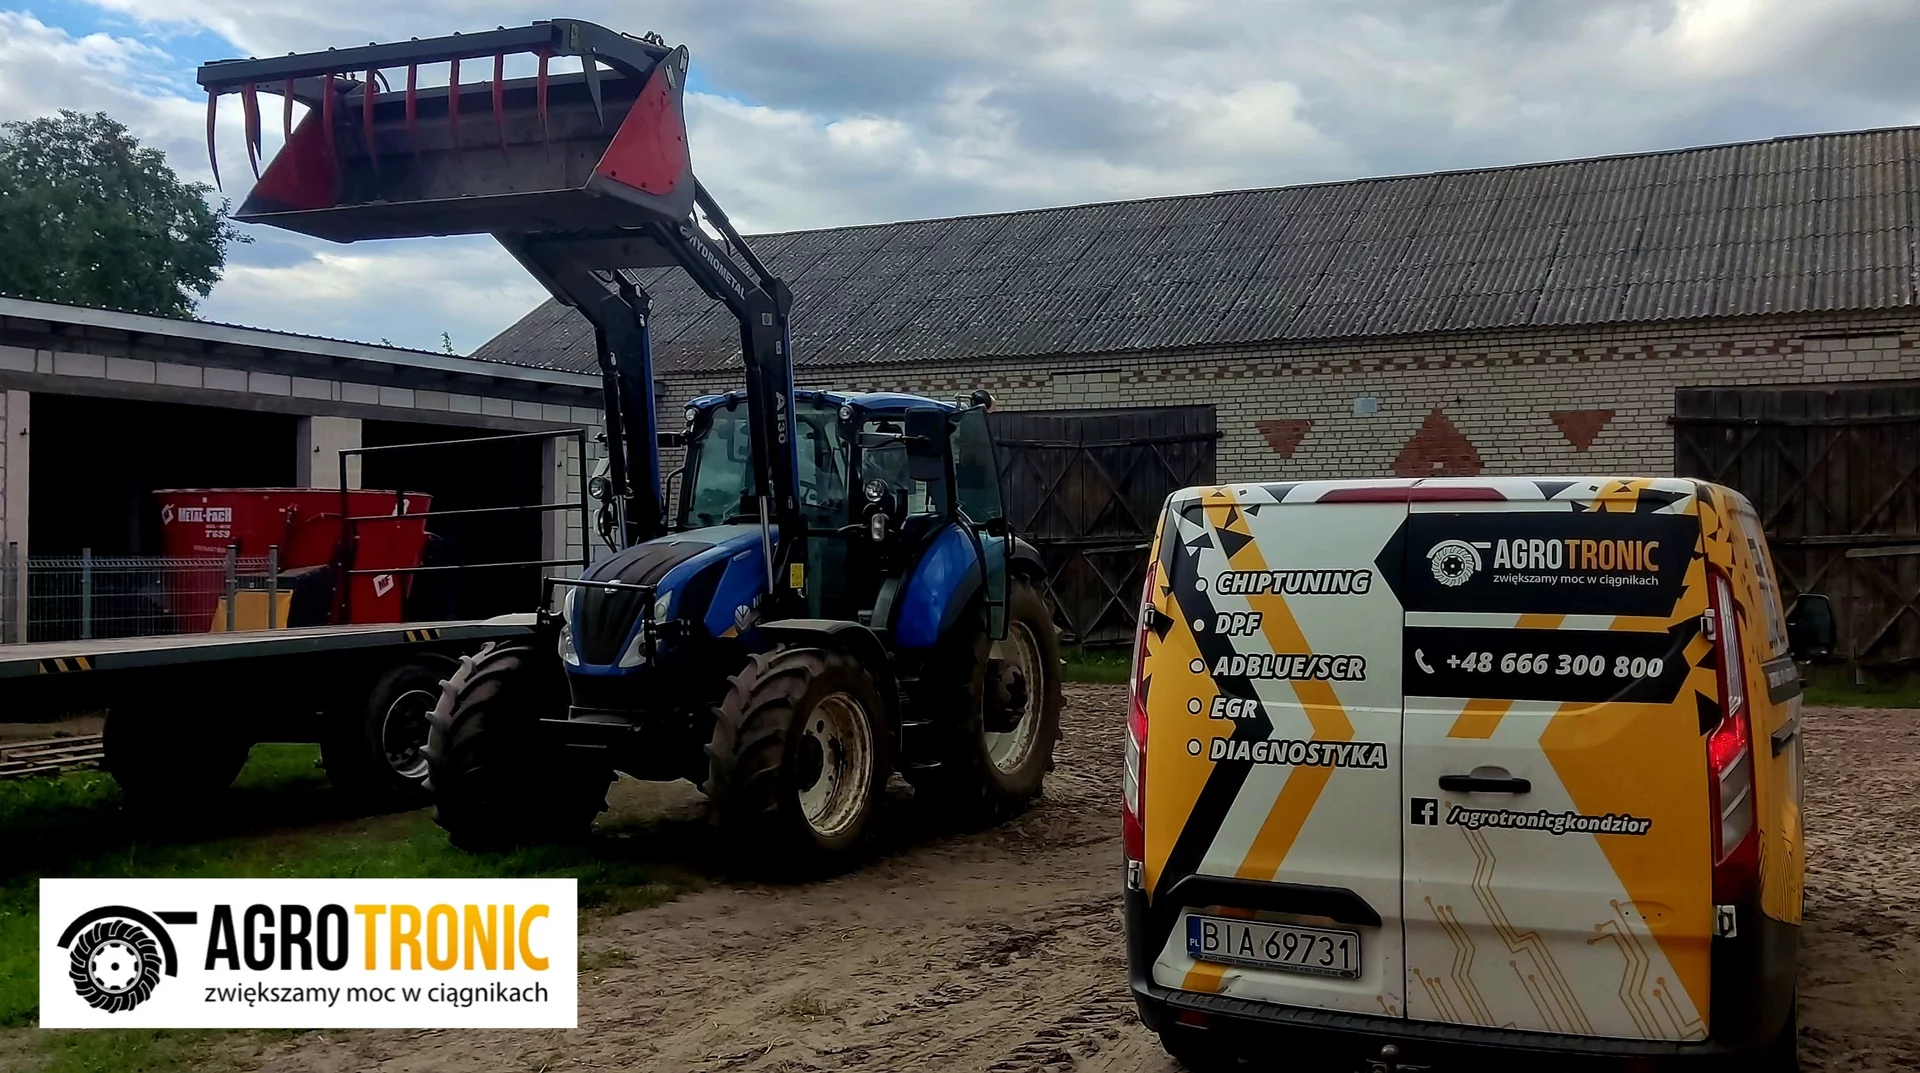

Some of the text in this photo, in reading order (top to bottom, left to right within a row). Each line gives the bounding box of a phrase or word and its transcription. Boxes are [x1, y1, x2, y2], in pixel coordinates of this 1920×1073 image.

[688, 235, 746, 300] HYDROMETAL
[775, 391, 788, 444] AT30
[178, 507, 232, 522] METAL-FACH
[1216, 571, 1371, 594] CHIPTUNING
[1492, 573, 1659, 587] zwiększamy moc w ciągnikach
[1214, 614, 1261, 634] DPF
[1211, 656, 1365, 679] ADBLUE/SCR
[1446, 652, 1664, 678] +48 666 300 800
[1210, 697, 1259, 719] EGR
[1210, 739, 1386, 767] DIAGNOSTYKA
[1449, 806, 1649, 833] /agrotronicgkondzior
[1189, 937, 1200, 947] PL
[1203, 921, 1255, 957] BIA
[1264, 930, 1350, 969] 69731
